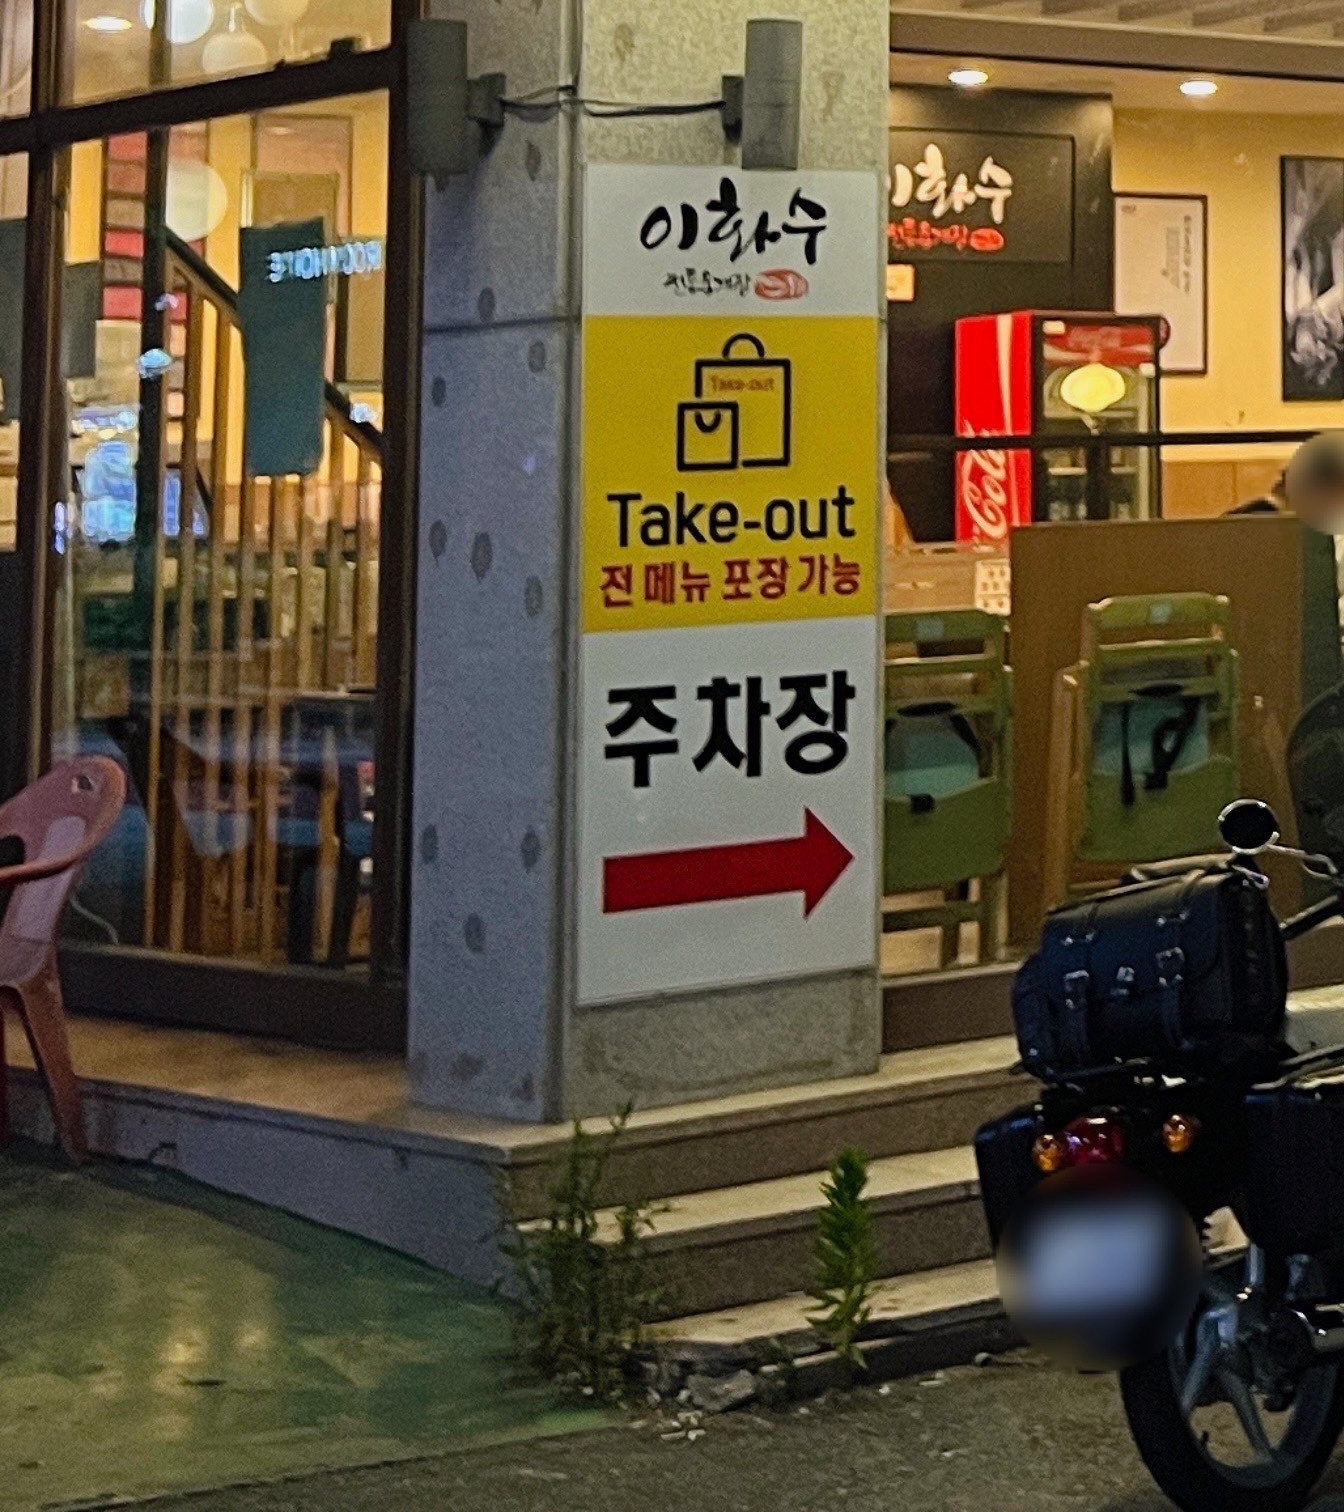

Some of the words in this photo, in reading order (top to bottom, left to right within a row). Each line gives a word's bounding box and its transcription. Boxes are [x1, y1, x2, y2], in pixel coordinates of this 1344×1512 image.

[640, 176, 828, 265] 이화수
[606, 485, 856, 548] Take-out
[601, 565, 633, 607] 전
[645, 561, 711, 605] 메뉴
[724, 557, 789, 600] 포장
[799, 553, 861, 596] 가능
[605, 670, 856, 788] 주차장
